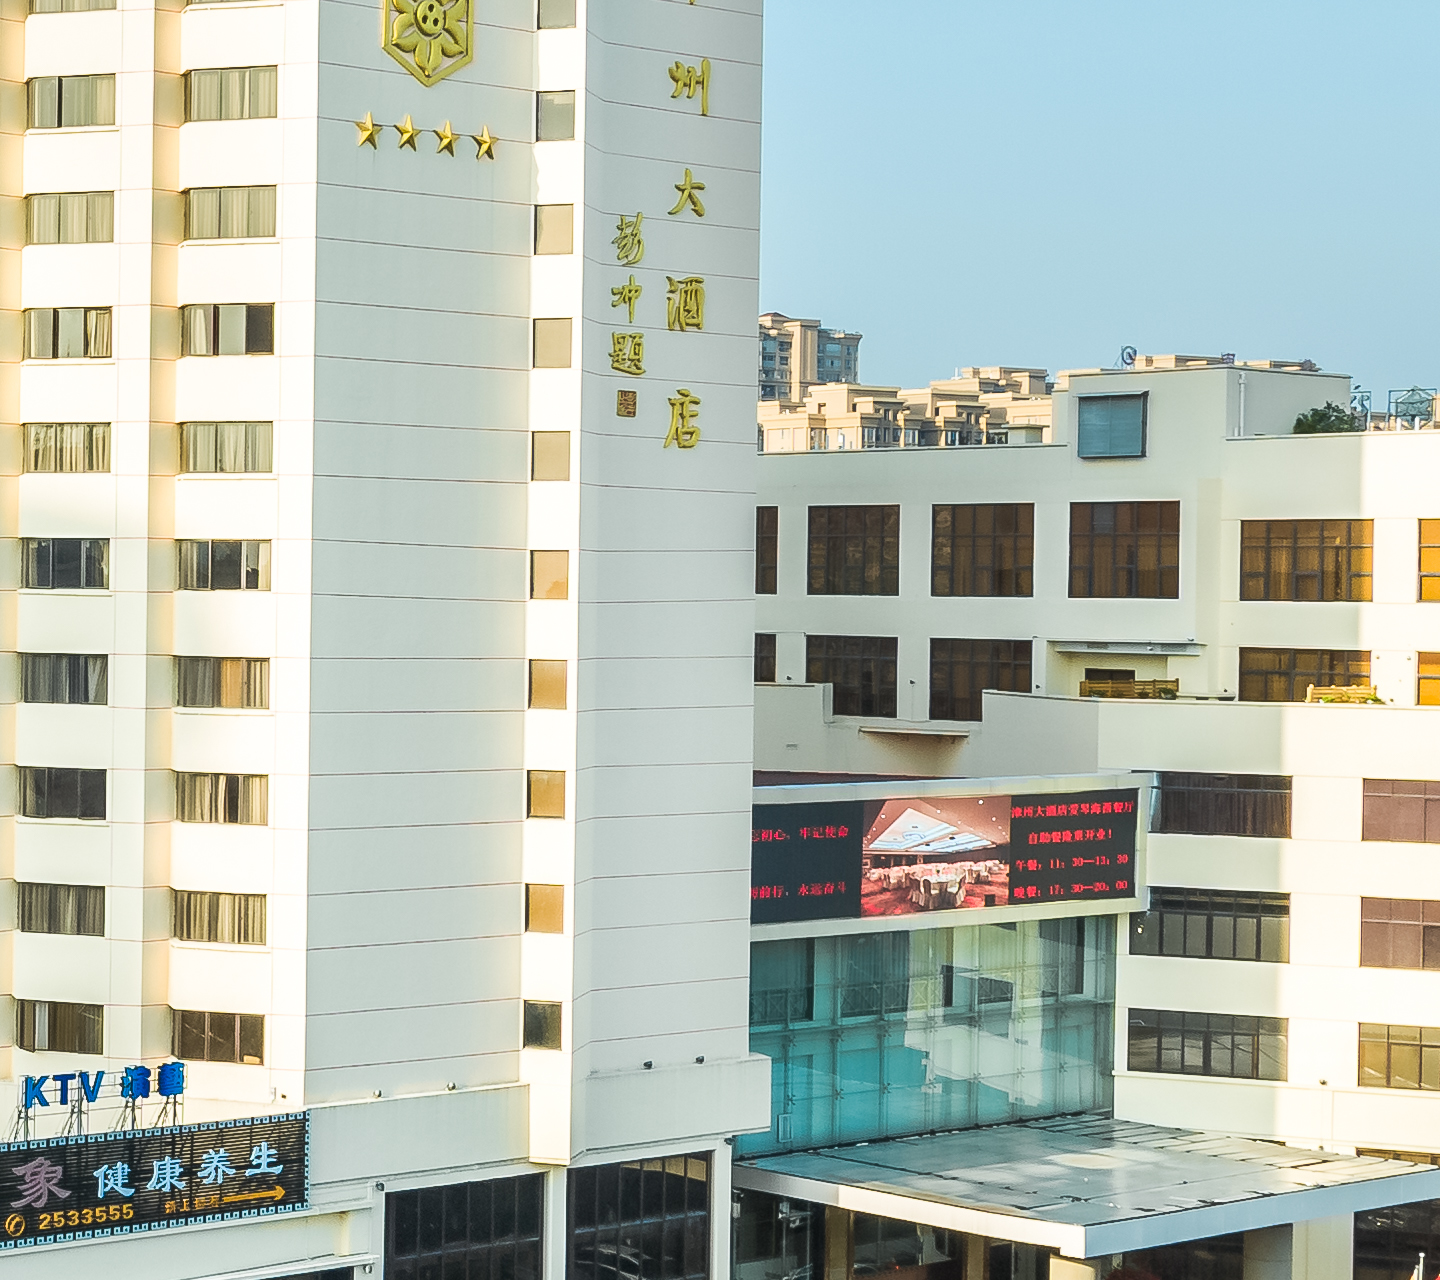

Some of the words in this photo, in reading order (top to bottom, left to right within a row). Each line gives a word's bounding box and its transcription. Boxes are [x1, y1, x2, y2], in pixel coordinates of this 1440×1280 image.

[25, 1070, 105, 1109] KTV
[93, 1141, 284, 1199] 健康养生
[38, 1203, 134, 1231] 2533555
